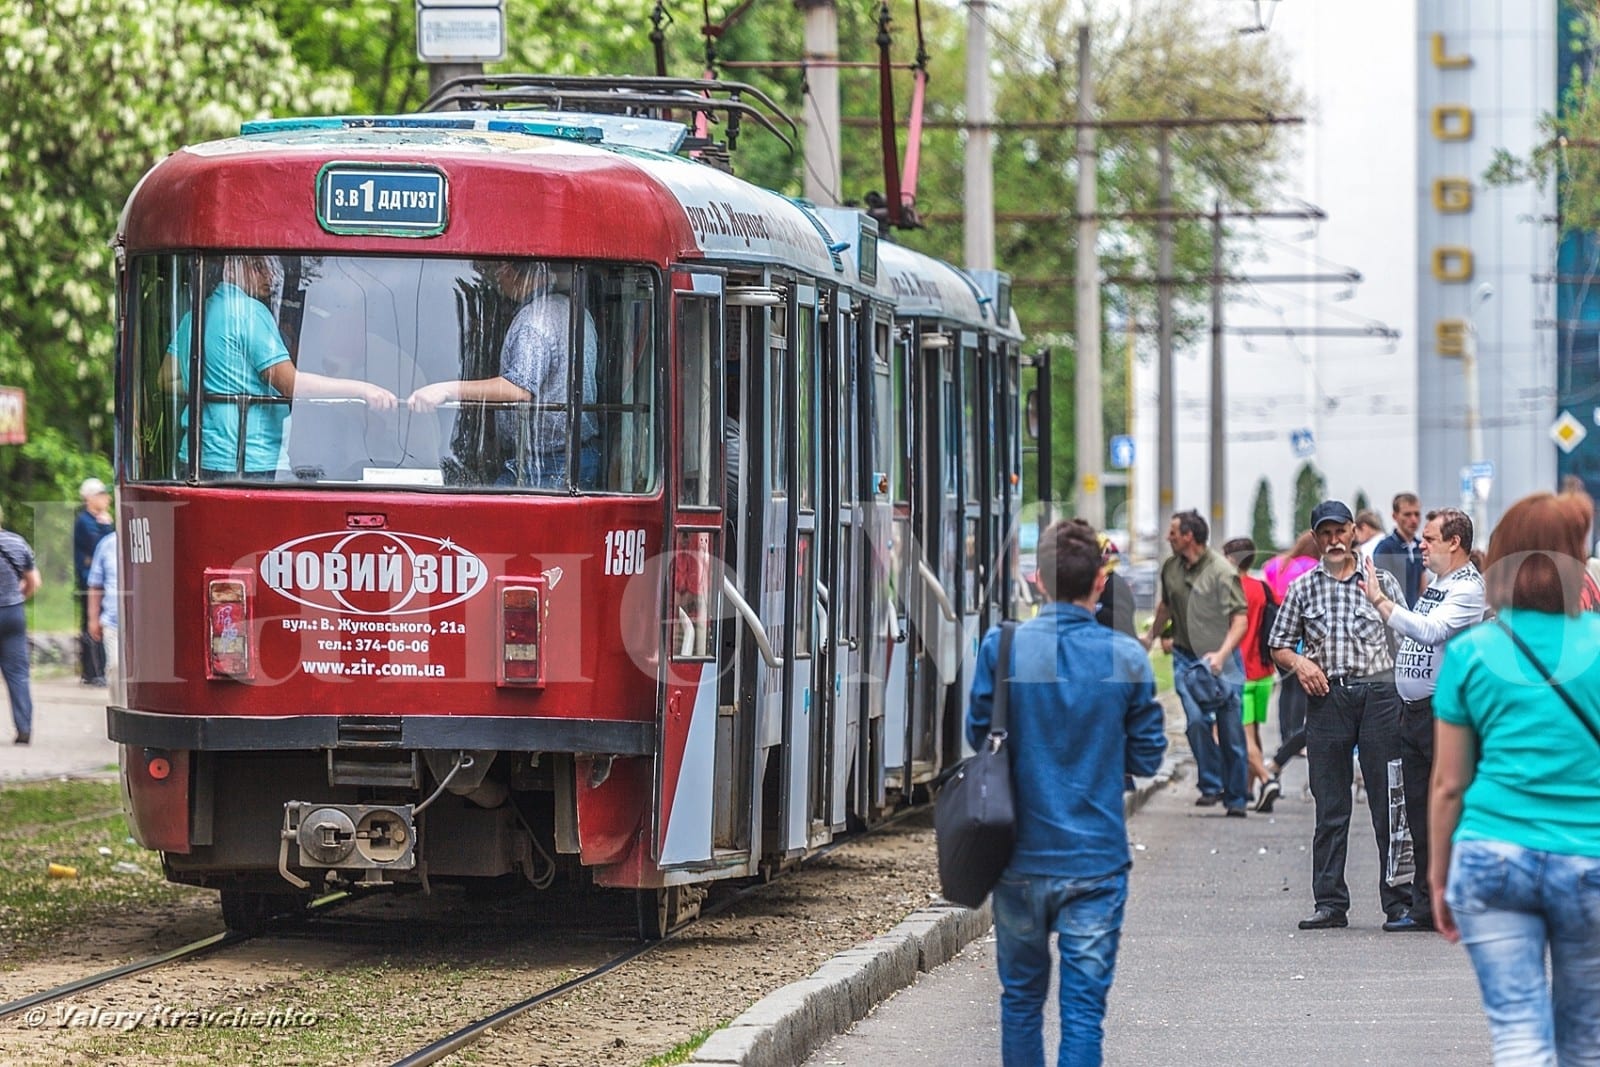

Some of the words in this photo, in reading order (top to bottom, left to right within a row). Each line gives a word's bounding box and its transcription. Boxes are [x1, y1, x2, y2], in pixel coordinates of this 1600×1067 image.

[360, 180, 375, 212] 1
[1431, 31, 1474, 357] LOGOS
[129, 517, 152, 564] 1396
[605, 529, 646, 576] 1396
[269, 545, 402, 593] НОВИЙ
[414, 554, 480, 594] ЗІР
[282, 618, 317, 632] вул.:
[321, 618, 335, 631] В.
[338, 618, 436, 635] Жуковського,
[440, 621, 466, 634] 21а
[318, 639, 352, 651] тел.:
[355, 639, 429, 653] 374-06-06
[302, 658, 446, 677] www.zir.com.ua
